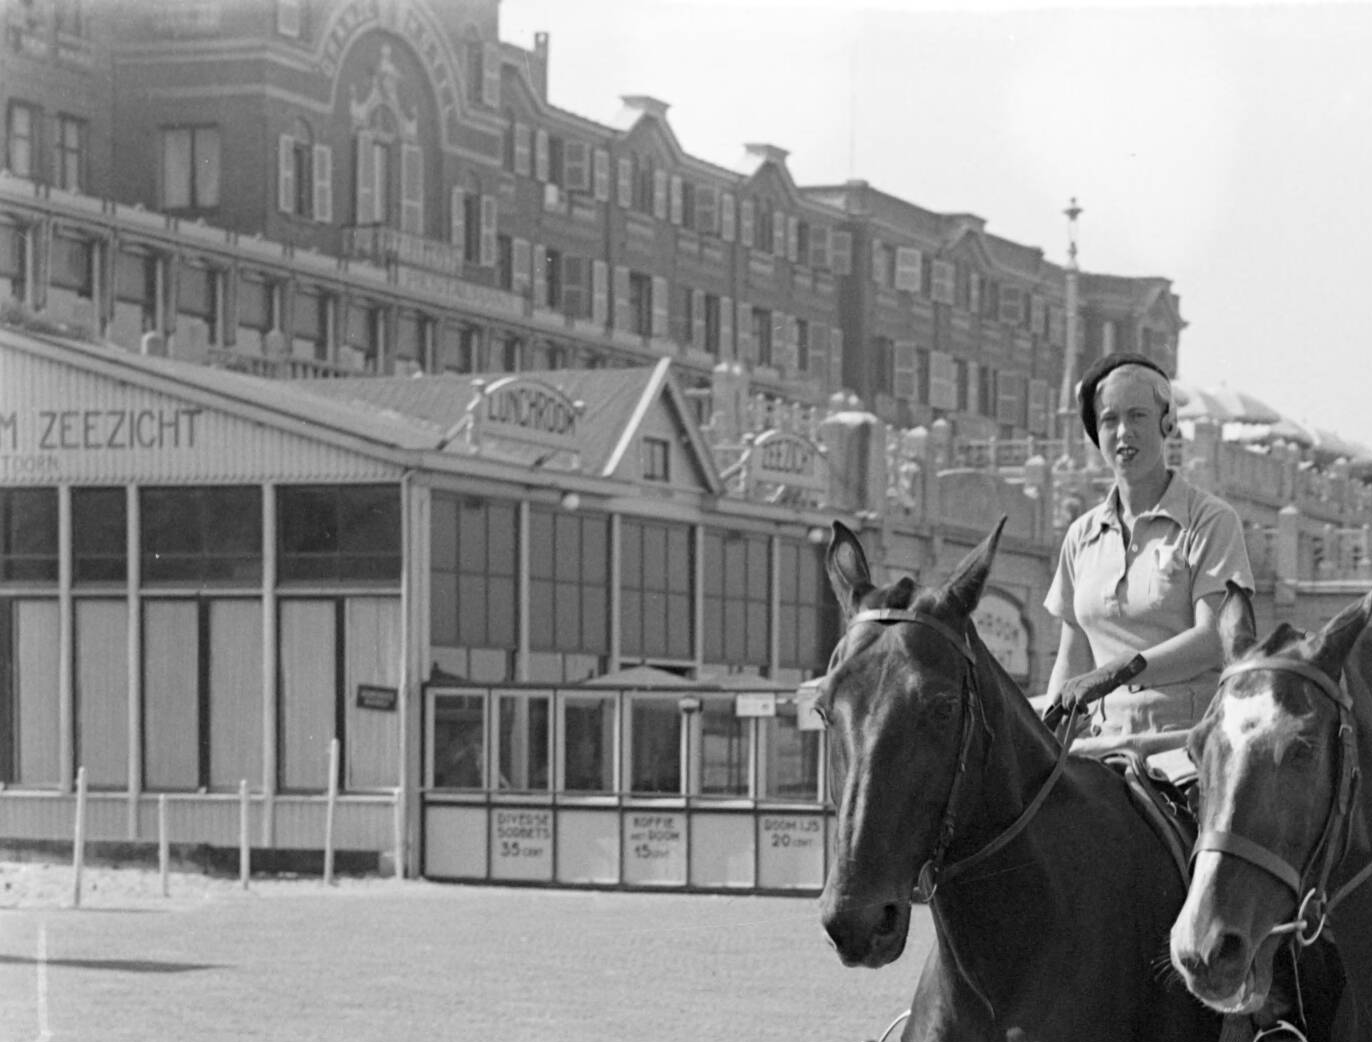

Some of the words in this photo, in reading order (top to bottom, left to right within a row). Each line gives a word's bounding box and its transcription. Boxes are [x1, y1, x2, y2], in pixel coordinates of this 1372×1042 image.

[488, 387, 576, 436] LUNCHROOM
[39, 409, 203, 449] ZEEZICHT
[500, 841, 520, 857] 35
[771, 833, 791, 848] 20
